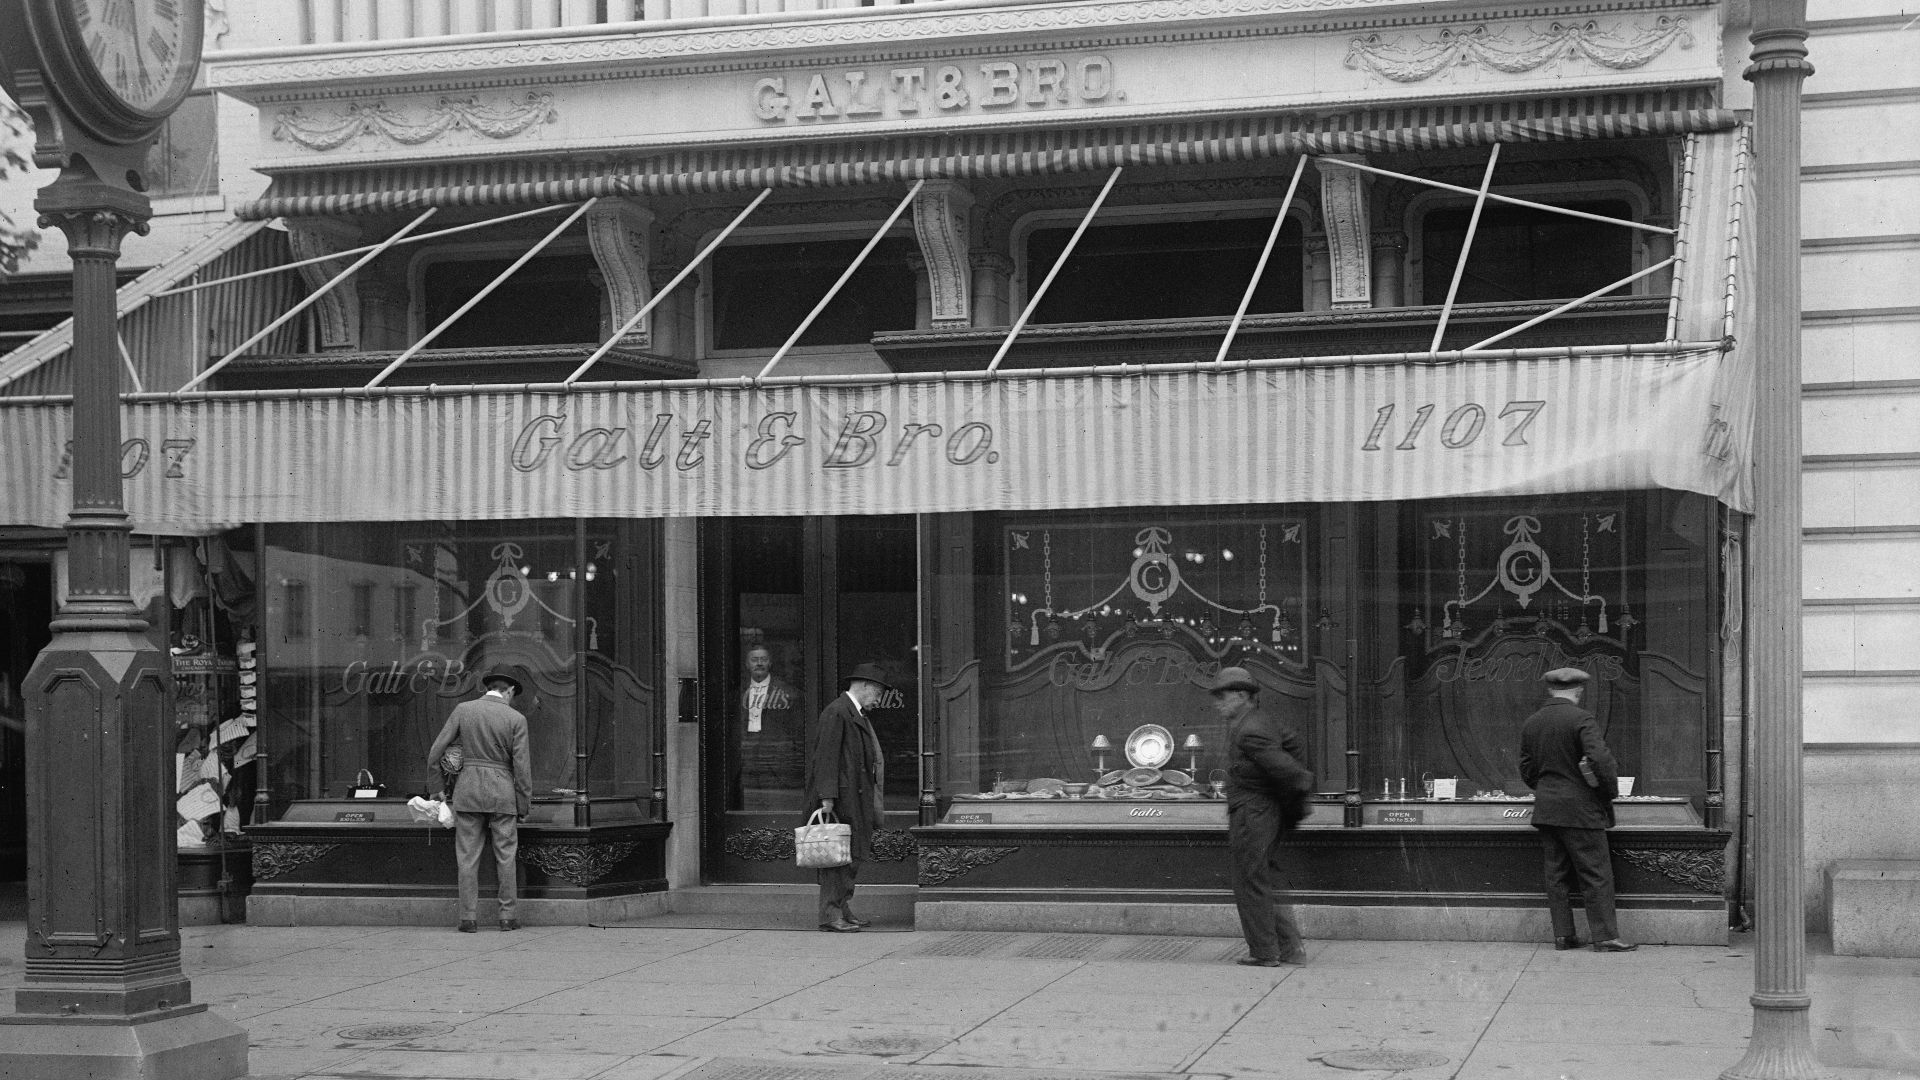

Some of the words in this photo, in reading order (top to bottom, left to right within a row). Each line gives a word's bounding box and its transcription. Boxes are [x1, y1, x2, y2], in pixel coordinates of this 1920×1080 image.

[510, 412, 712, 472] Galt
[744, 411, 806, 471] &
[822, 411, 1000, 469] Bro.
[1361, 400, 1546, 451] 1107
[53, 438, 196, 480] 107
[1141, 563, 1165, 591] G
[1511, 552, 1535, 583] G
[497, 577, 517, 604] G
[342, 660, 408, 694] Galt
[409, 660, 436, 693] &
[1129, 807, 1164, 818] Galt's
